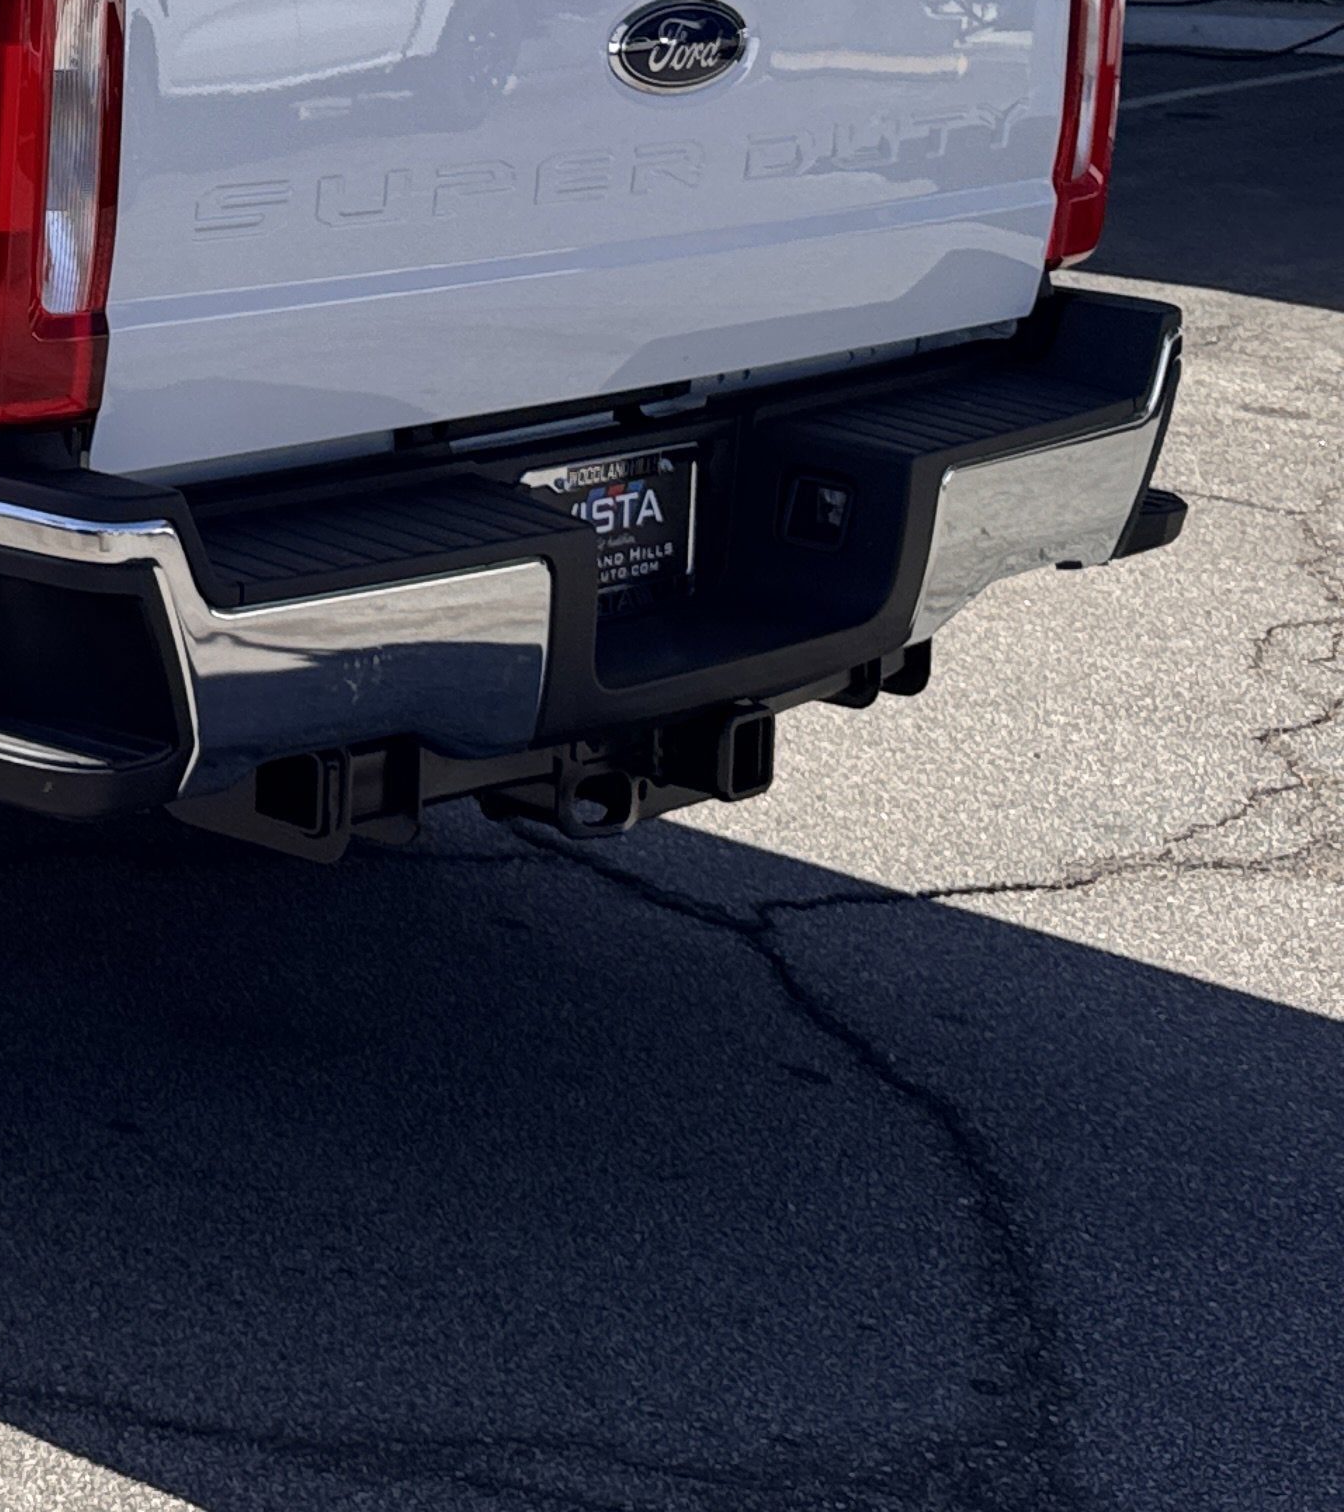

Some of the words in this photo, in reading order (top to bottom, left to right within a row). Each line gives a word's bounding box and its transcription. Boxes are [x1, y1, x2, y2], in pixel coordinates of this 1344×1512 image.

[647, 17, 724, 73] Ford
[191, 138, 707, 242] SUPER
[742, 96, 1030, 181] DUTY
[629, 541, 674, 562] HILLS
